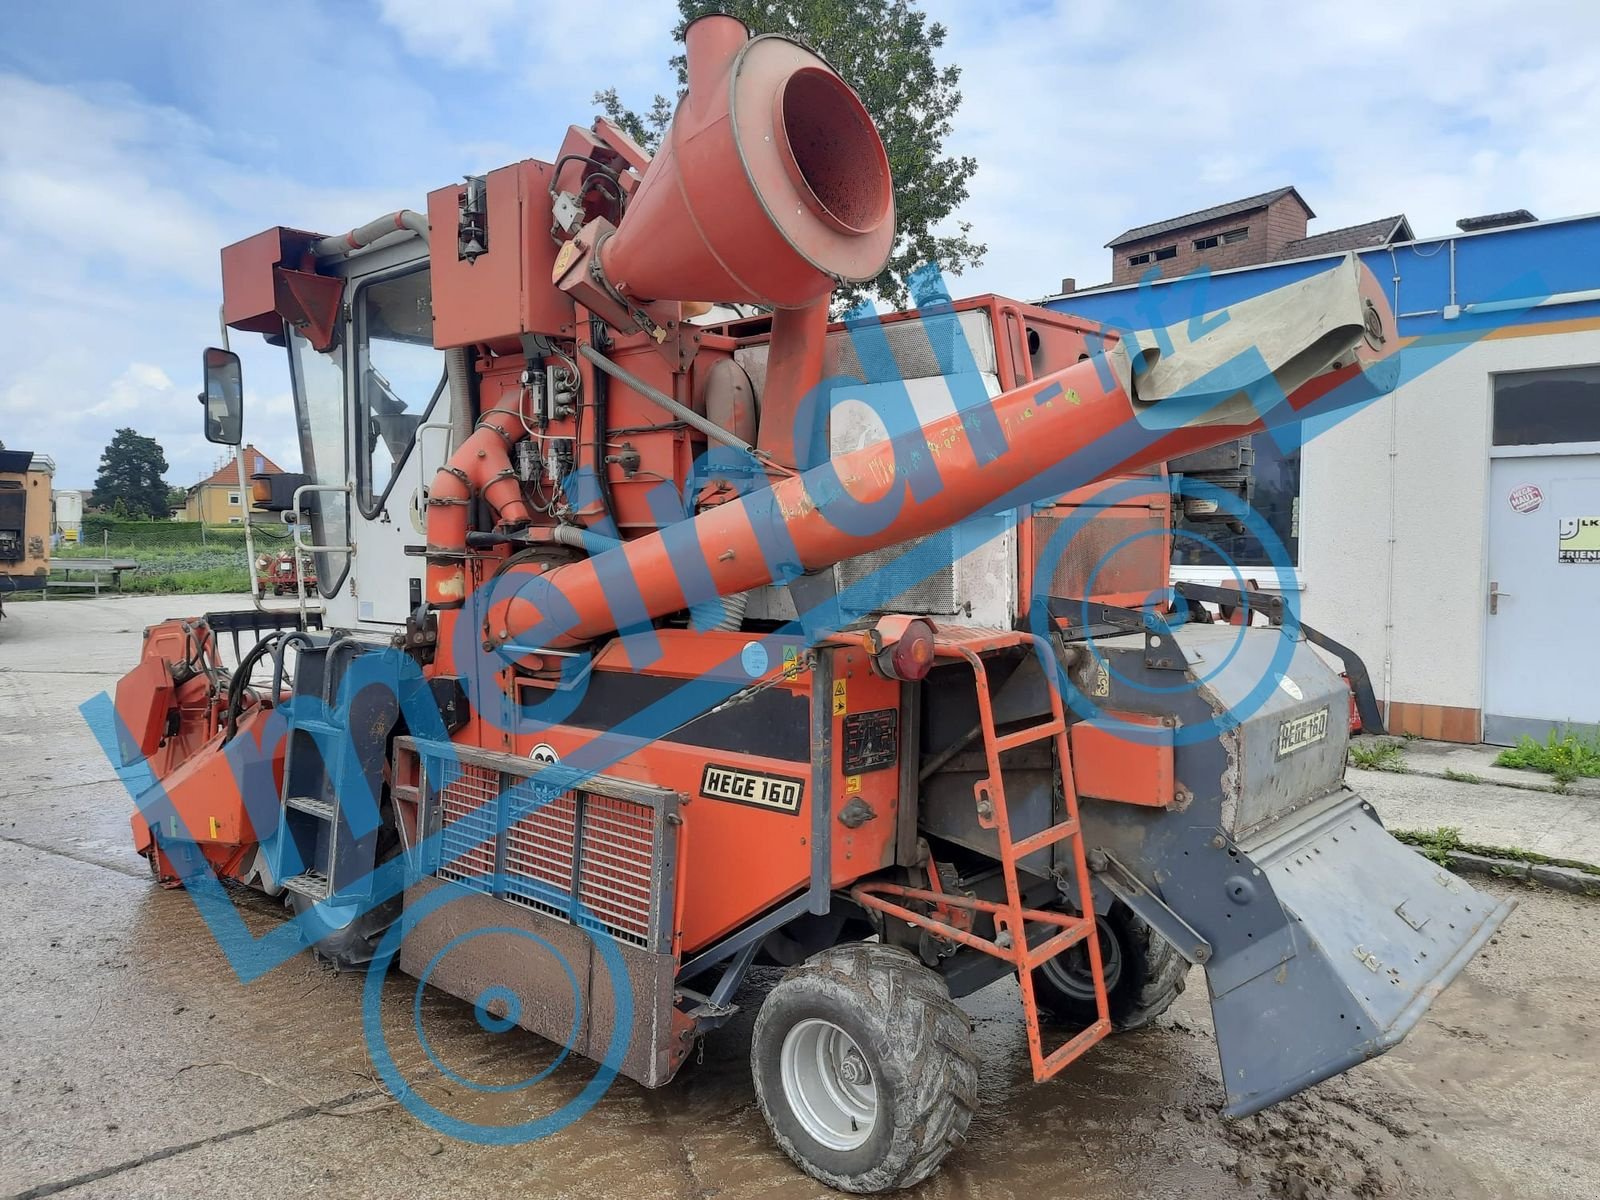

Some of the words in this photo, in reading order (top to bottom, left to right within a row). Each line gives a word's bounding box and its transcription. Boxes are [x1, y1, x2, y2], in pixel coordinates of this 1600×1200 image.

[1581, 519, 1600, 527] LK
[707, 771, 756, 798] HEGE
[761, 781, 795, 806] 160
